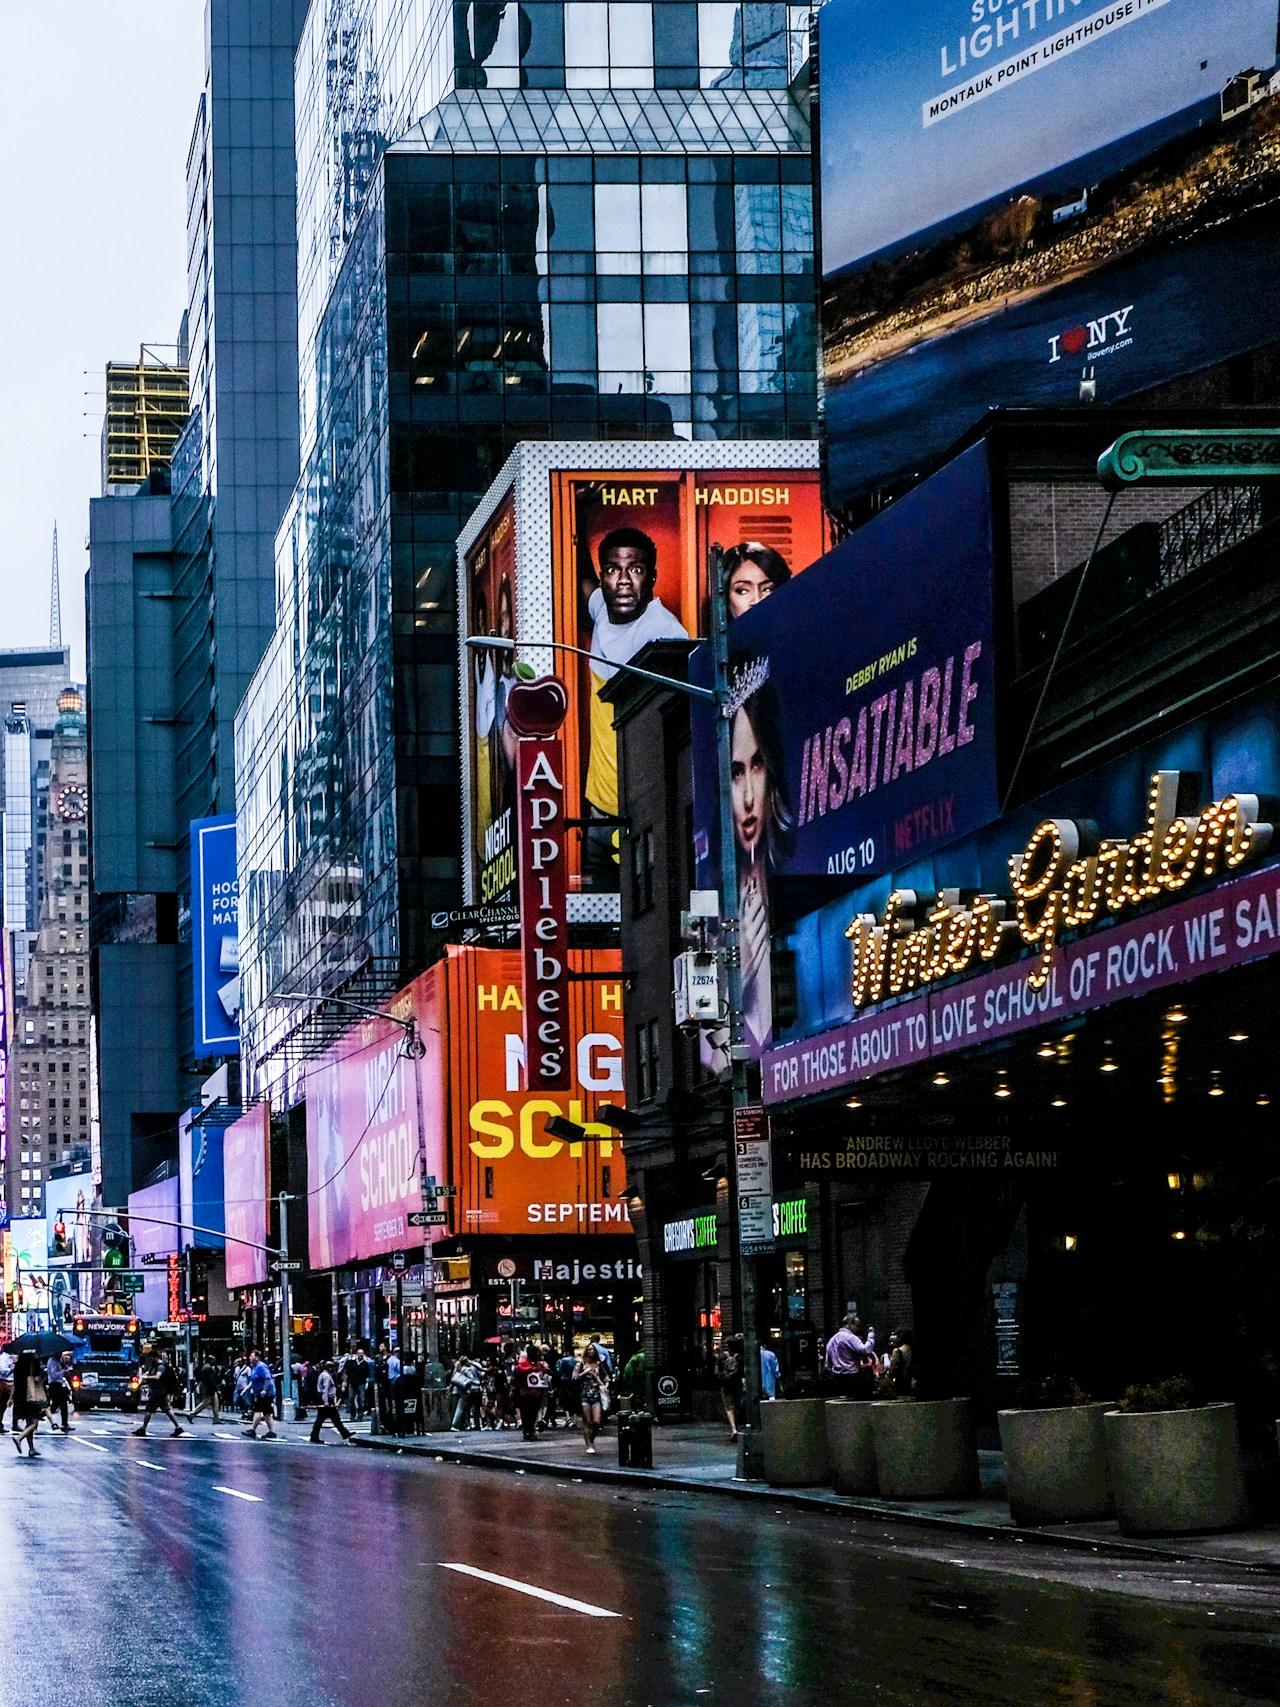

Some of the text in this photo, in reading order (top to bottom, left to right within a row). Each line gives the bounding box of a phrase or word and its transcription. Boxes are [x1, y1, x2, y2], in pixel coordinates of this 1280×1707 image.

[929, 3, 1134, 118] MONTAUK POINT LIGHTHOUSE
[1048, 305, 1133, 364] I NY
[1087, 337, 1134, 361] iloveny.com
[602, 488, 790, 506] HART HADDISH
[846, 636, 918, 695] DEBBY RYAN IS
[798, 639, 982, 828] INSATIABLE
[485, 812, 511, 865] NIGHT
[894, 793, 954, 857] NETFLIX
[481, 846, 517, 904] SCHOOL
[827, 837, 875, 875] AUG 10
[523, 750, 566, 1078] Applebee's
[693, 973, 715, 985] 72674
[801, 1040, 847, 1086] THOSE
[850, 1020, 903, 1072] ABOUT
[905, 1013, 928, 1052] TO
[931, 994, 978, 1045] LOVE
[982, 972, 1064, 1030] SCHOOL
[1069, 949, 1098, 1003] OF
[1106, 924, 1179, 986] ROCK,
[1184, 908, 1227, 962] WE
[363, 1036, 408, 1128] NIGHT
[360, 1120, 418, 1212] SCHOOL
[738, 1143, 745, 1155] 3
[800, 1152, 832, 1169] HAS
[834, 1152, 923, 1169] BROADWAY
[927, 1152, 998, 1169] ROCKING
[442, 1187, 450, 1195] 50
[741, 1197, 748, 1208] 6
[415, 1215, 443, 1223] ONE WAY
[663, 1218, 696, 1253] GREGORYS
[695, 1214, 718, 1248] COFFEE
[780, 1198, 809, 1236] COFFEE
[488, 1278, 506, 1286] EST.
[104, 1323, 126, 1331] YORK
[799, 1339, 808, 1353] P
